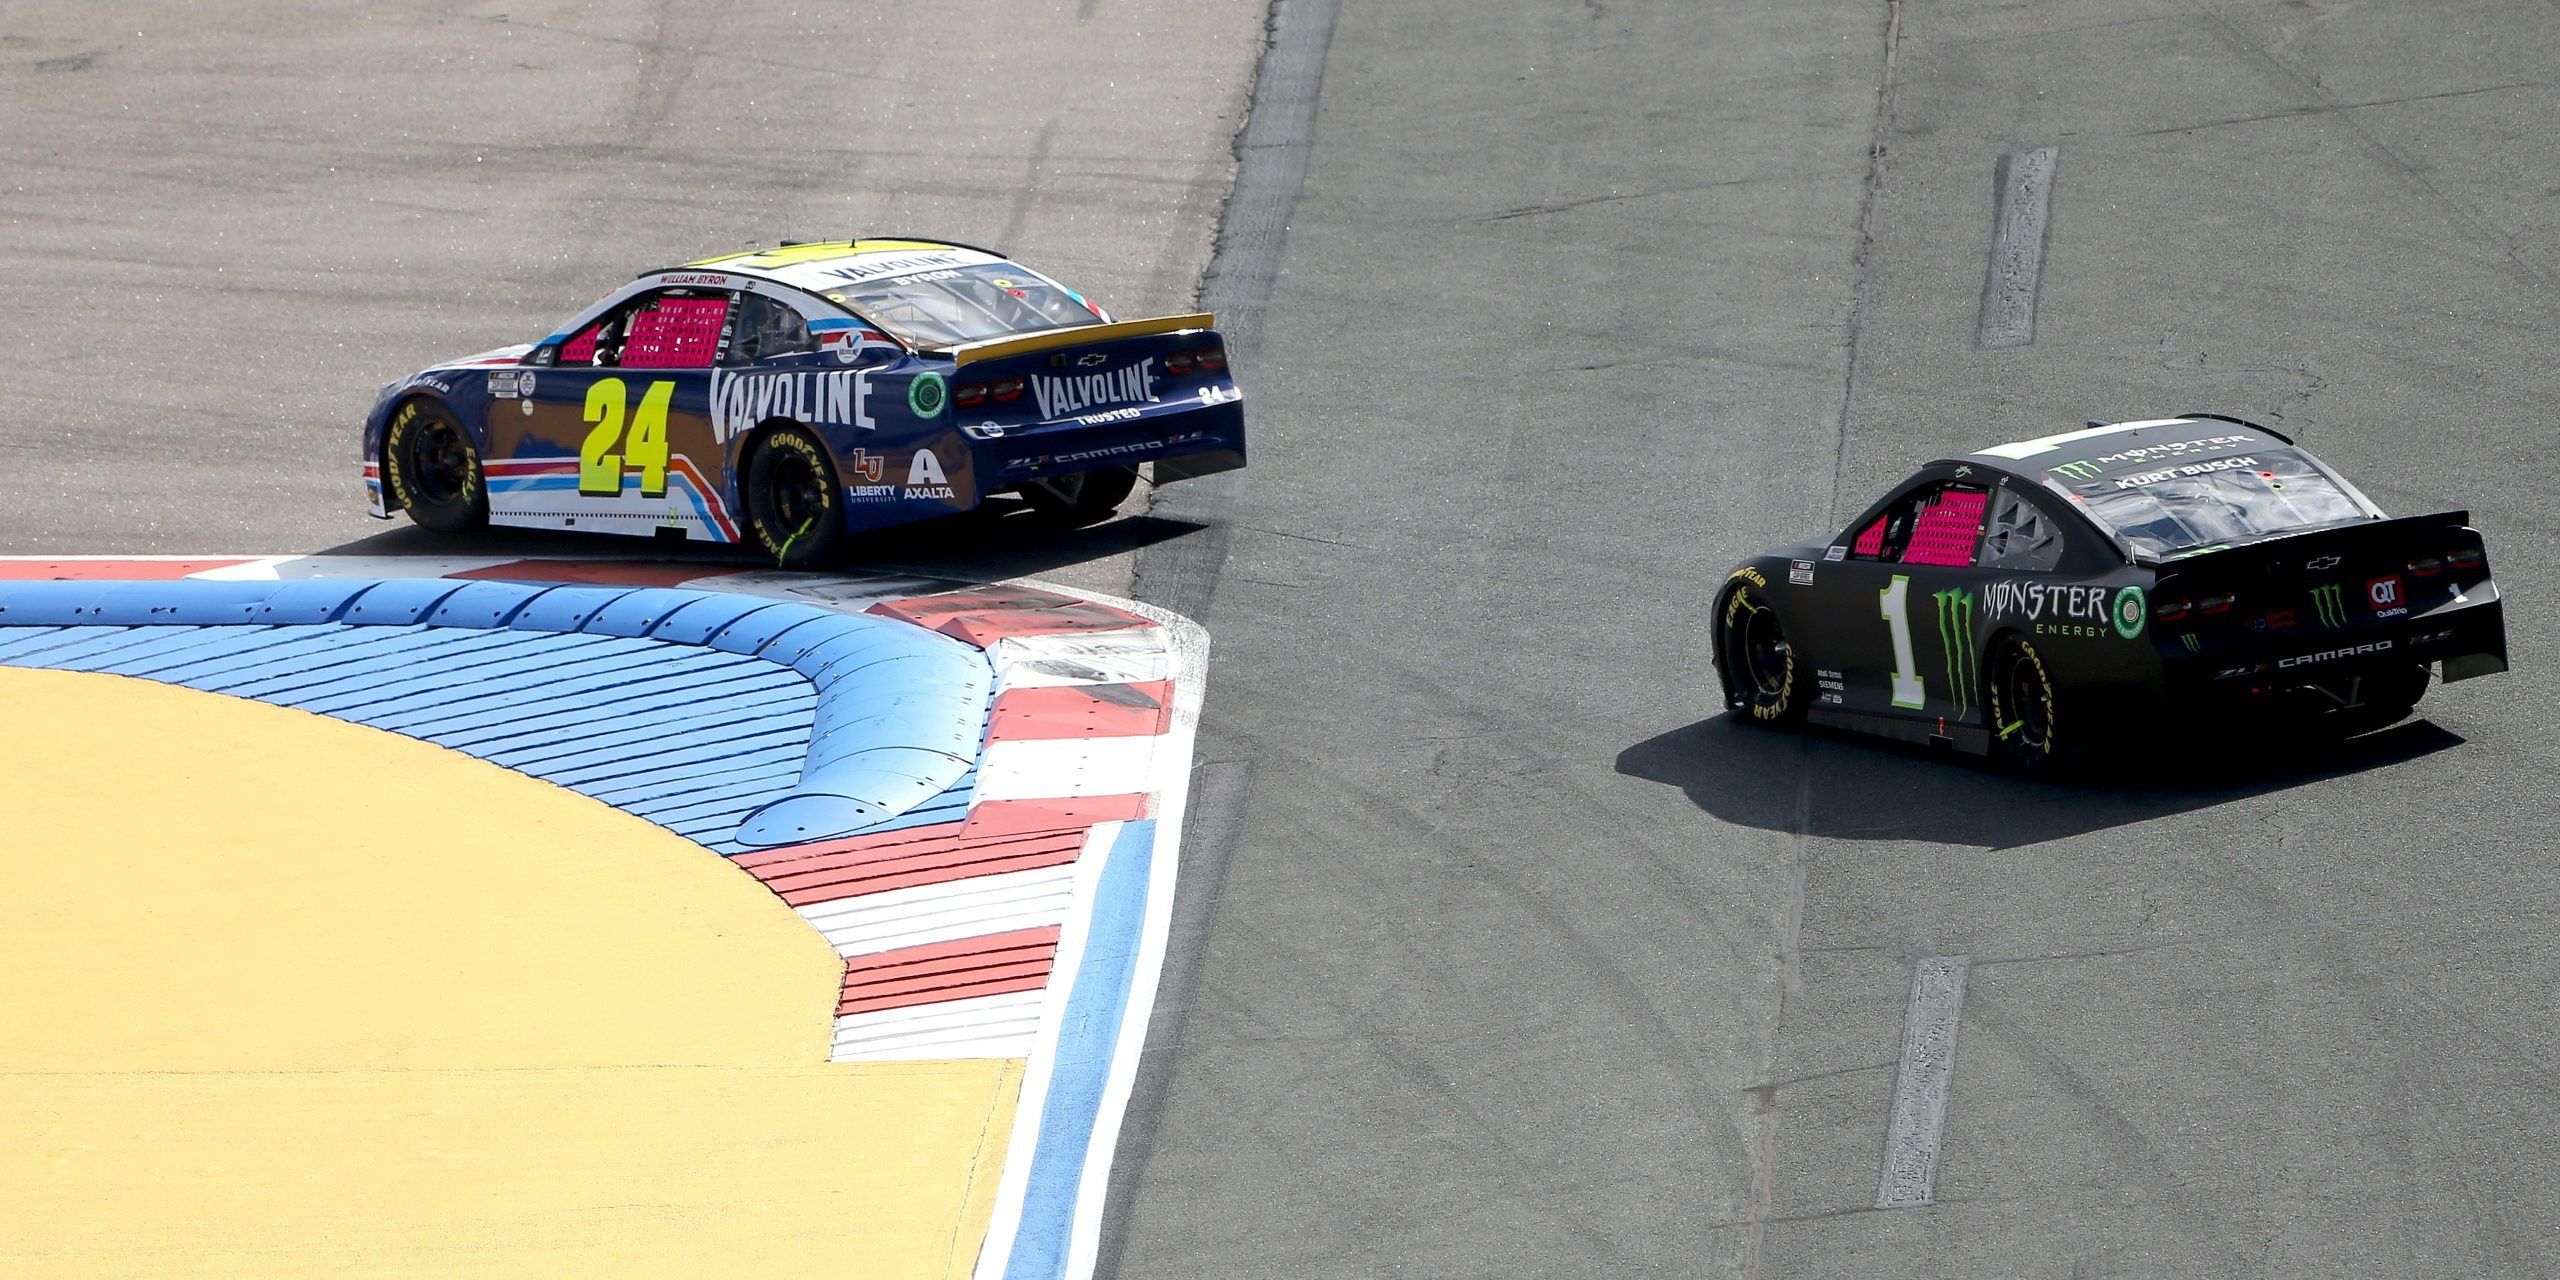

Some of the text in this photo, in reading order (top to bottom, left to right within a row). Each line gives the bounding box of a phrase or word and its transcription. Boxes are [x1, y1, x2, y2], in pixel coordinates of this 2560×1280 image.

[818, 253, 970, 281] VALVOLINE
[891, 269, 963, 286] BYRON
[660, 275, 727, 285] WILLIAM BYRON
[1031, 357, 1160, 421] VALVOLINE
[1198, 385, 1225, 405] 24
[710, 366, 886, 445] VALVOLINE
[1077, 407, 1142, 427] TRUSTED
[579, 377, 677, 499] 24
[388, 403, 416, 509] GOODYEAR
[1053, 441, 1164, 464] CAMARO
[2133, 443, 2242, 463] ENERGY
[770, 433, 830, 508] GOODYEAR
[2115, 456, 2260, 490] KURT BUSCH
[850, 485, 895, 497] LIBERTY
[904, 487, 955, 499] AXALTA
[2371, 580, 2396, 604] QT
[2448, 582, 2469, 604] 1
[1726, 586, 1748, 628] EAGE
[2377, 607, 2408, 618] QuikTrip
[1879, 574, 1926, 711] 1
[2035, 624, 2107, 638] ENERGY
[2278, 640, 2393, 669] CAMARO
[1753, 643, 1794, 721] GOODYEAR
[1818, 680, 1844, 691] SIEMENS
